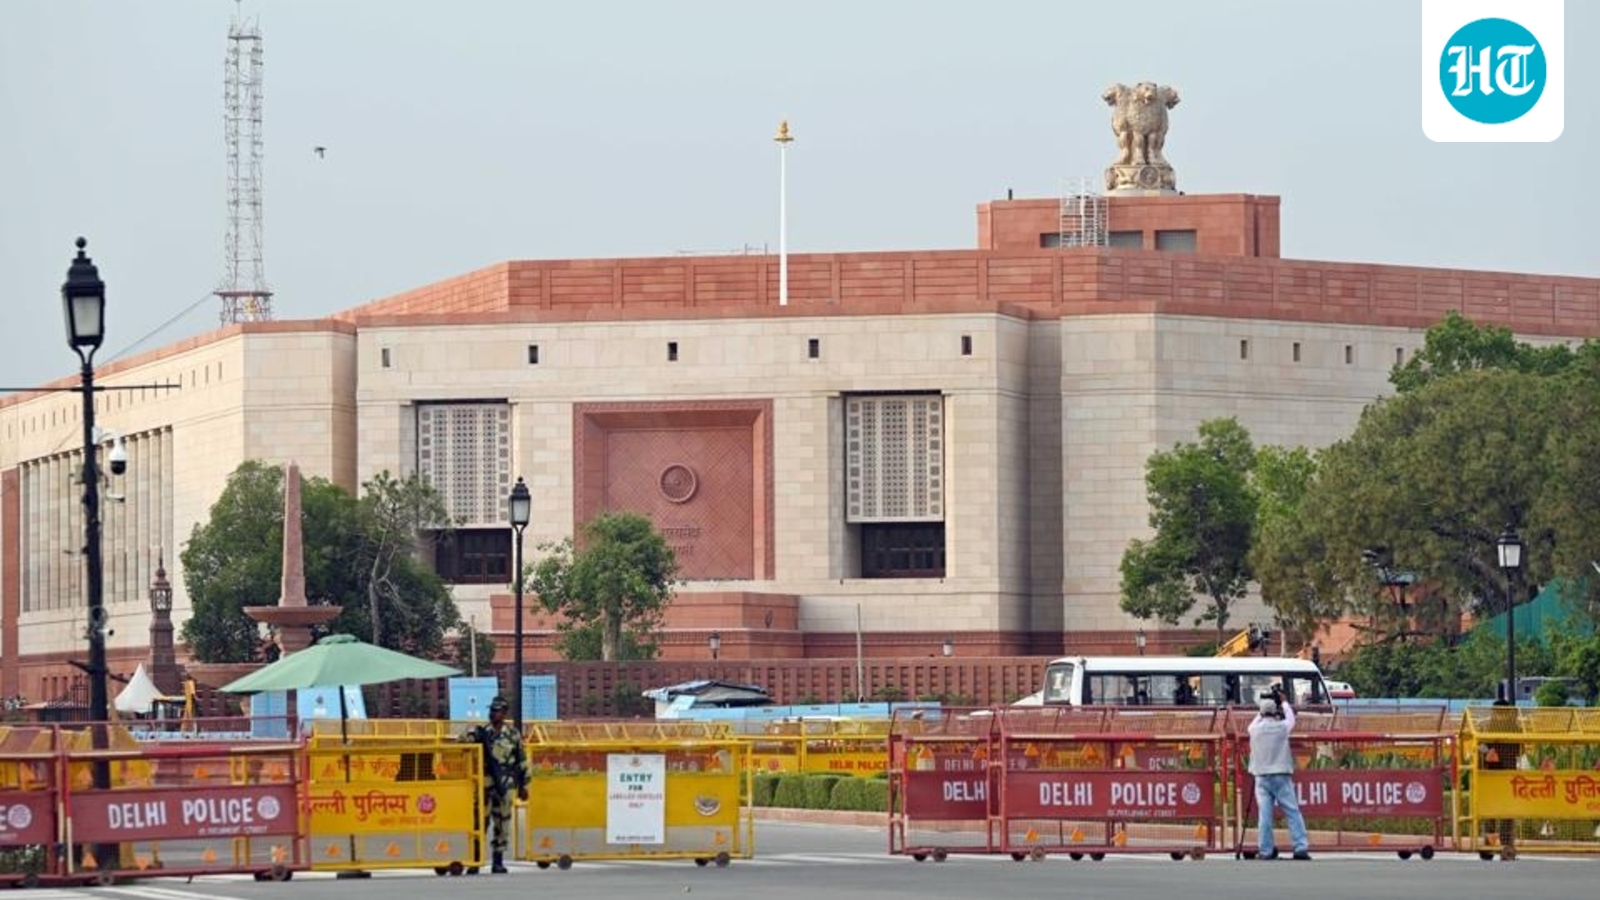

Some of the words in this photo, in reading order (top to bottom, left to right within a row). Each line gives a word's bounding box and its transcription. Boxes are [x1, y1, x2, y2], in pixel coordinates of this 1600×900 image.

[619, 772, 652, 783] ENTRY
[1510, 774, 1558, 801] दिल्ली
[1562, 774, 1600, 804] पुलि
[352, 789, 410, 822] पुलिस
[1039, 782, 1093, 806] DELHI
[1111, 782, 1177, 806] POLICE
[1296, 781, 1328, 805] LHI
[1342, 781, 1403, 805] POLICE
[108, 801, 167, 829] DELHI
[182, 797, 254, 825] POLICE
